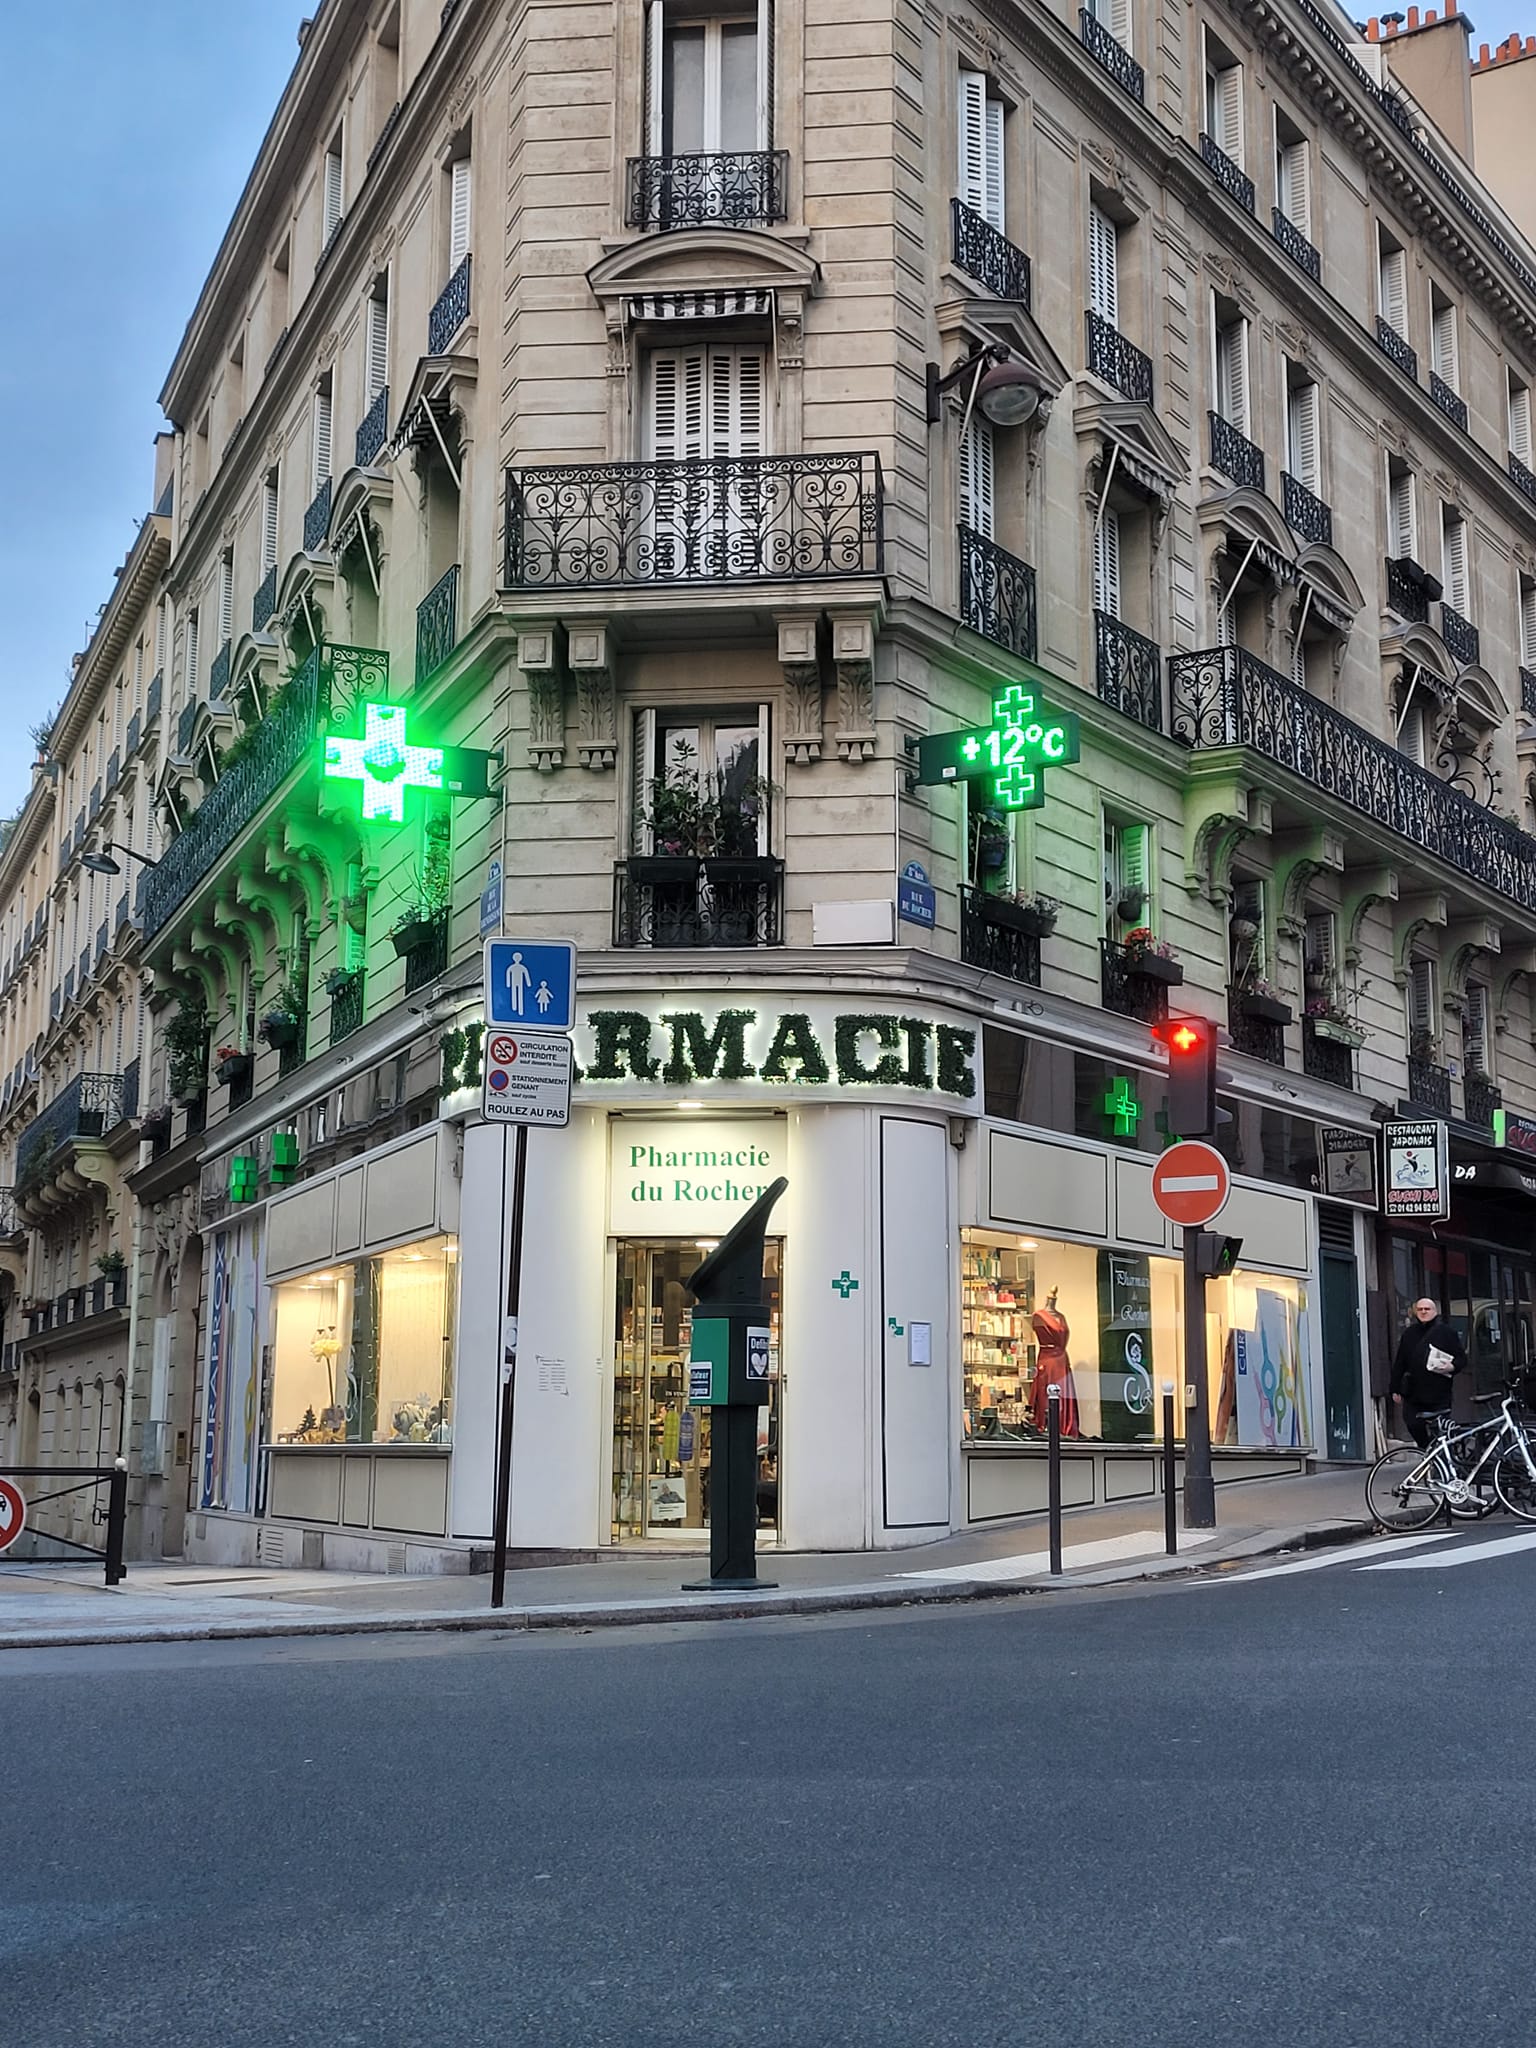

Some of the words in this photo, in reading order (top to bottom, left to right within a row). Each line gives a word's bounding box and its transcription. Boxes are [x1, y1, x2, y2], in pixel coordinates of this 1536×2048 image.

[520, 1042, 569, 1053] CIRCULATION
[519, 1051, 558, 1061] INTERDITE
[512, 1075, 567, 1085] STATIONNEMENT
[487, 1104, 528, 1116] ROULEZ
[529, 1107, 544, 1117] AU
[546, 1109, 566, 1119] PAS
[1387, 1124, 1437, 1136] RESTAURANT
[1392, 1135, 1433, 1147] JAPONAIS
[628, 1144, 771, 1168] Pharmacie
[1454, 1165, 1477, 1180] DA
[631, 1180, 663, 1202] du
[673, 1179, 768, 1202] Rocher
[1388, 1190, 1422, 1203] SUSHI
[1422, 1189, 1439, 1203] DA
[204, 1247, 224, 1495] CURAPROX
